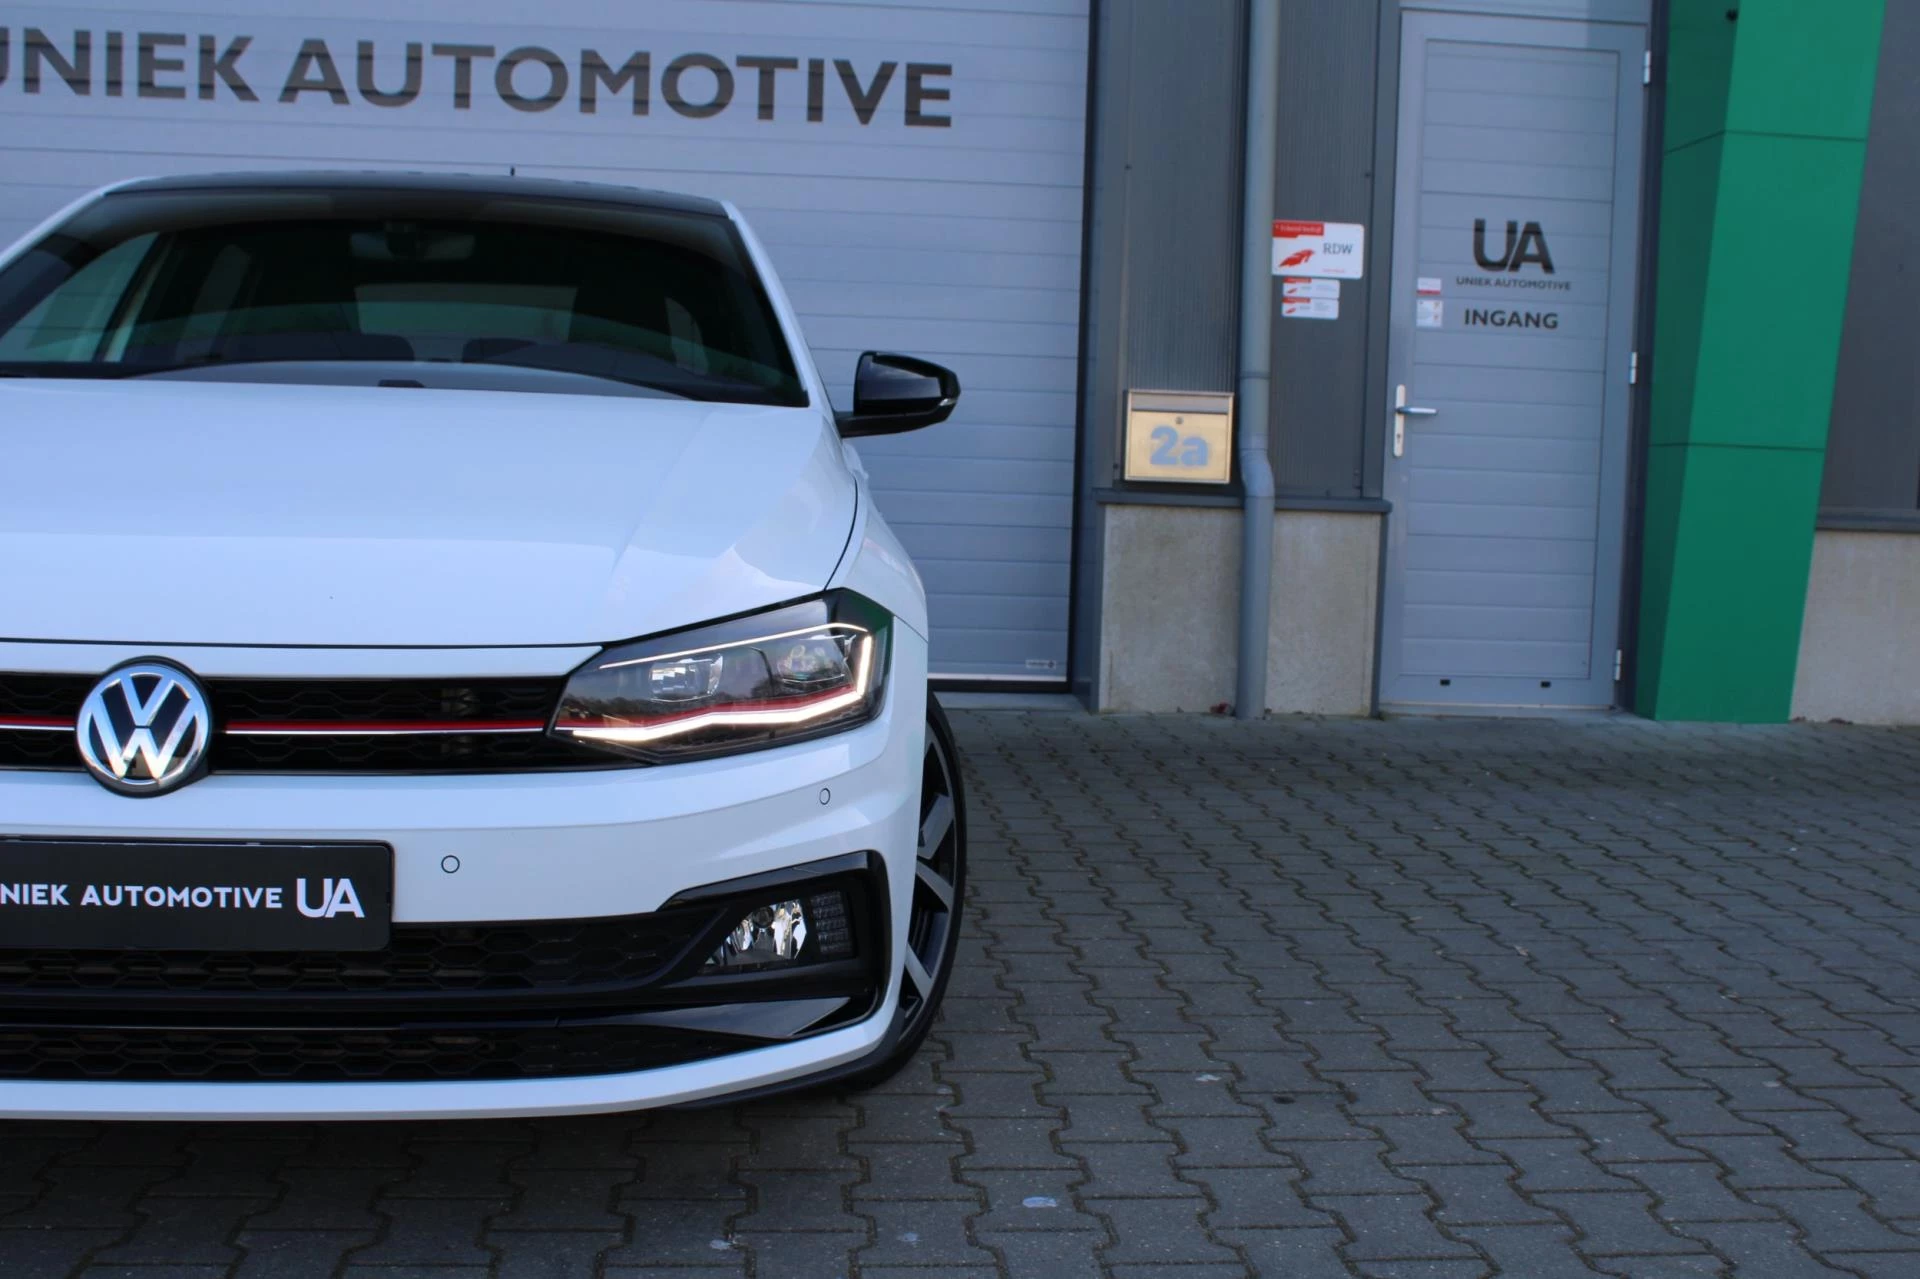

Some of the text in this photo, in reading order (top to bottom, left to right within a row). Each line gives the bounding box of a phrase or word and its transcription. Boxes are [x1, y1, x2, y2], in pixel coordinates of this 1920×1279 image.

[0, 27, 952, 127] NIEK AUTOMOTIVE
[1323, 242, 1354, 256] RDW
[1474, 219, 1555, 274] UA
[1456, 276, 1572, 292] UNIEK AUTOMOTIVE
[1465, 308, 1559, 330] INGANG
[1149, 425, 1209, 467] 2a
[81, 884, 283, 909] AUTOMOTIVE
[297, 878, 366, 918] UA
